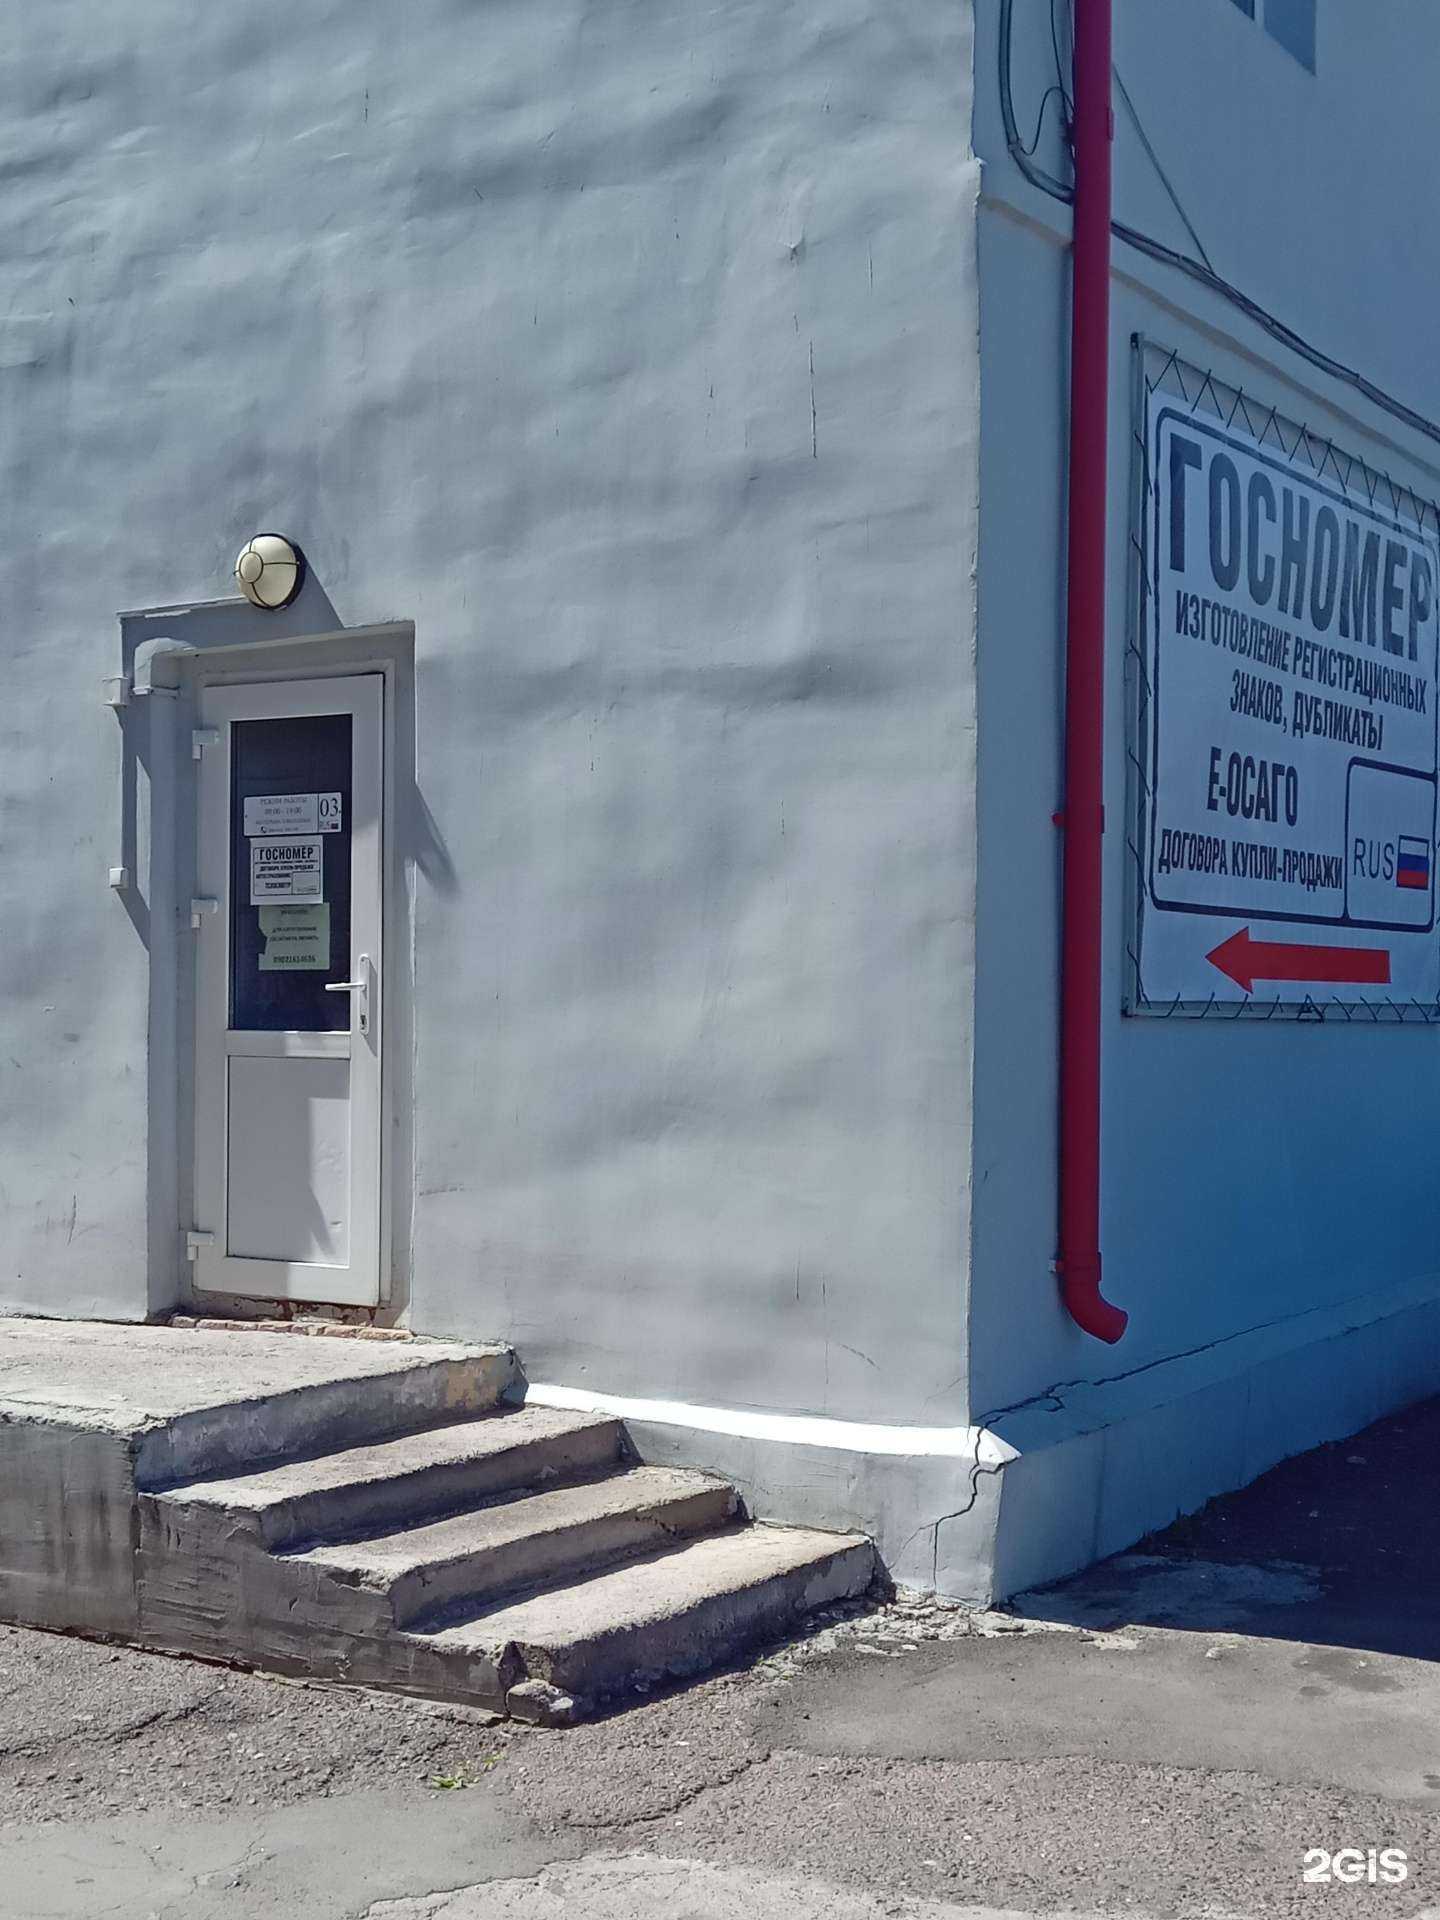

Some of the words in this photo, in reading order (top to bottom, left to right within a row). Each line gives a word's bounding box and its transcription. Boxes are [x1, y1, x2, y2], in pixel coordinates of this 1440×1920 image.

[1169, 432, 1432, 662] ГОСНОМЕР
[1175, 589, 1292, 673] ИЗГОТОВЛЕНИЕ
[1292, 636, 1428, 715] РЕГИСТРАЦИОННЫХ
[1230, 668, 1287, 734] ЗНАКОВ,
[1292, 691, 1384, 751] ДУБЛИКАТЫ
[320, 797, 339, 817] 03
[1206, 746, 1298, 827] Е-ОСАГО
[259, 847, 314, 861] ГОСНОМЕР
[1158, 828, 1228, 874] ДОГОВОРА
[1231, 841, 1343, 893] КУПЛИ-ПРОДАЖИ
[1353, 838, 1395, 880] RUS
